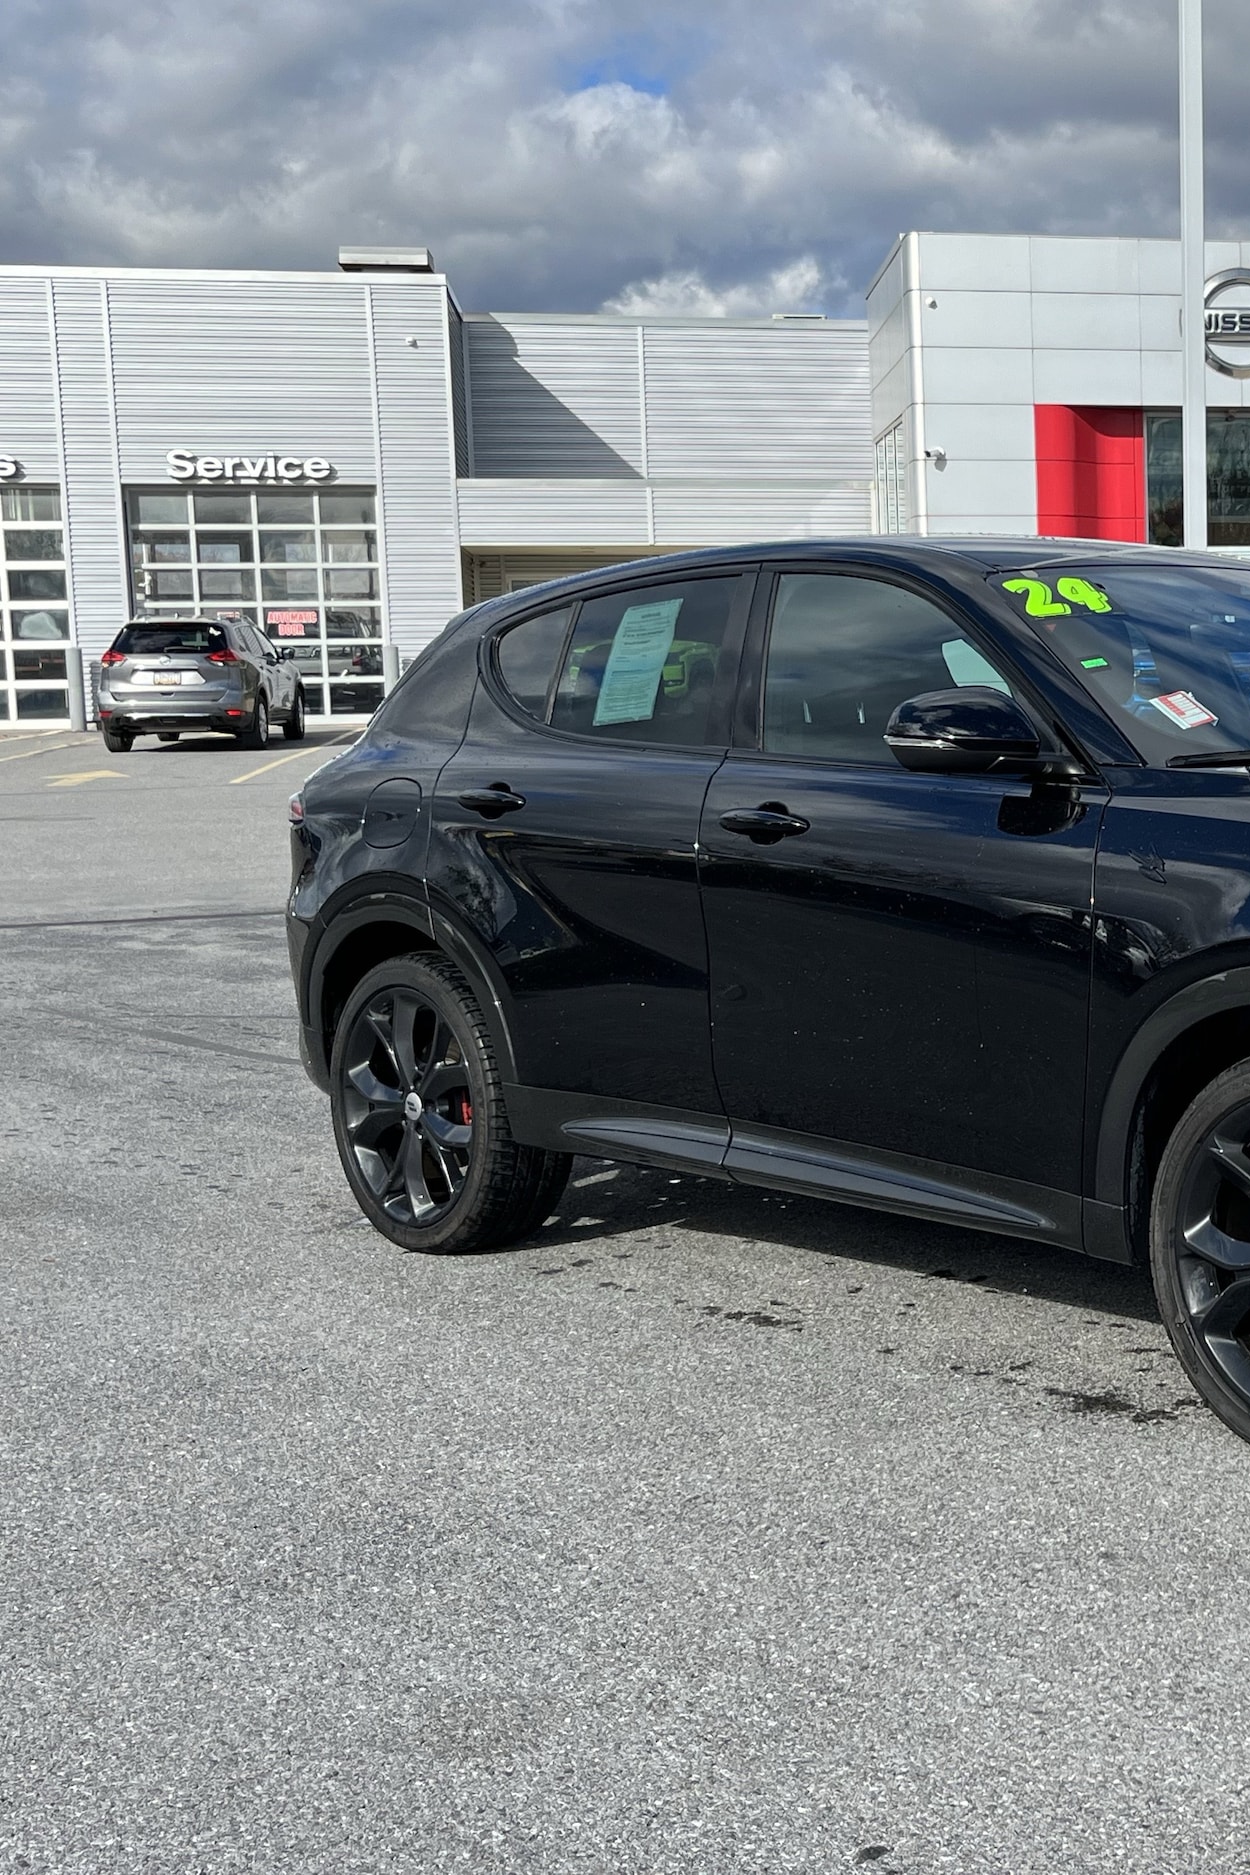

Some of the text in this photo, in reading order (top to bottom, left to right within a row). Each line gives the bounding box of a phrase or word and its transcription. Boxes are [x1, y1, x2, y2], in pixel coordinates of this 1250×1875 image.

[166, 448, 332, 479] Service
[1002, 577, 1112, 618] 24
[267, 611, 318, 624] AUTOMATIC
[278, 623, 305, 636] DOOR
